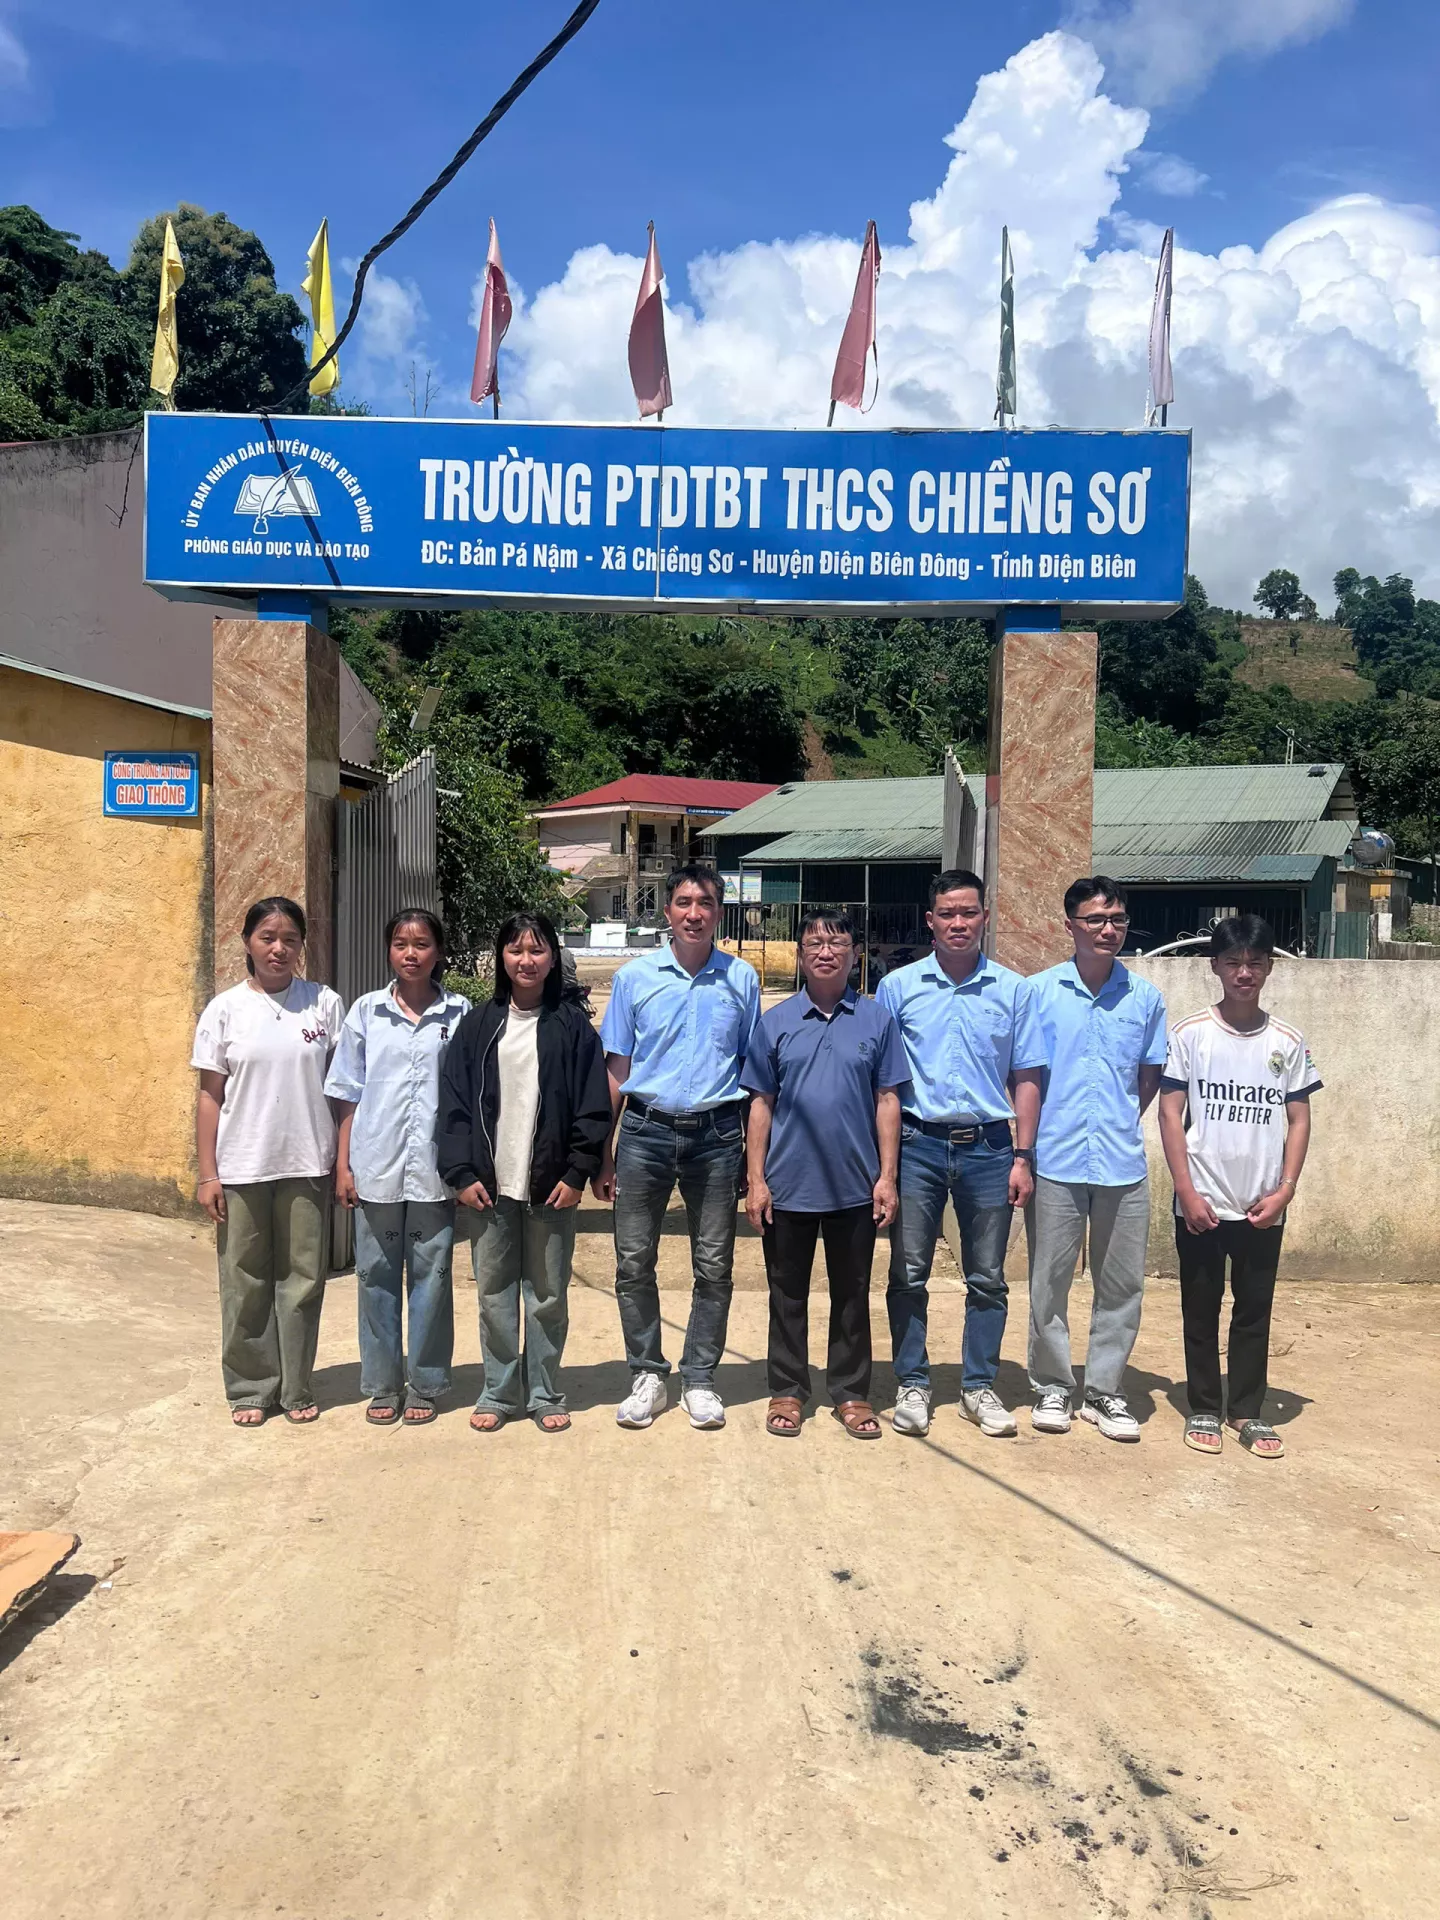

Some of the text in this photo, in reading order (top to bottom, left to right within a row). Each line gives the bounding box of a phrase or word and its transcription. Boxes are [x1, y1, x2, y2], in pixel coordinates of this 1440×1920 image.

[181, 438, 374, 533] ỦY BAN NHÂN DÂN HUYỆN ĐIỆN BIÊN ĐÔNG
[420, 447, 1152, 535] TRƯỜNG PTDTBT THCS CHIỀNG SƠ
[184, 536, 370, 561] PHÒNG GIÁO DỤC VÀ ĐÀO TẠO
[421, 540, 454, 565] ĐC:
[460, 539, 497, 567] Bản
[502, 540, 528, 567] Pá
[533, 541, 578, 574] Nậm
[601, 546, 627, 571] Xã
[633, 545, 703, 577] Chiềng
[709, 547, 734, 574] Sơ
[753, 549, 814, 580] Huyện
[820, 550, 865, 580] Điện
[870, 551, 915, 577] Biên
[920, 552, 970, 581] Đông
[991, 550, 1033, 578] Tỉnh
[1039, 553, 1085, 583] Điện
[1091, 554, 1136, 579] Biên
[117, 781, 185, 805] GIAO THÔNG
[1205, 1103, 1272, 1125] FLY BETTER
